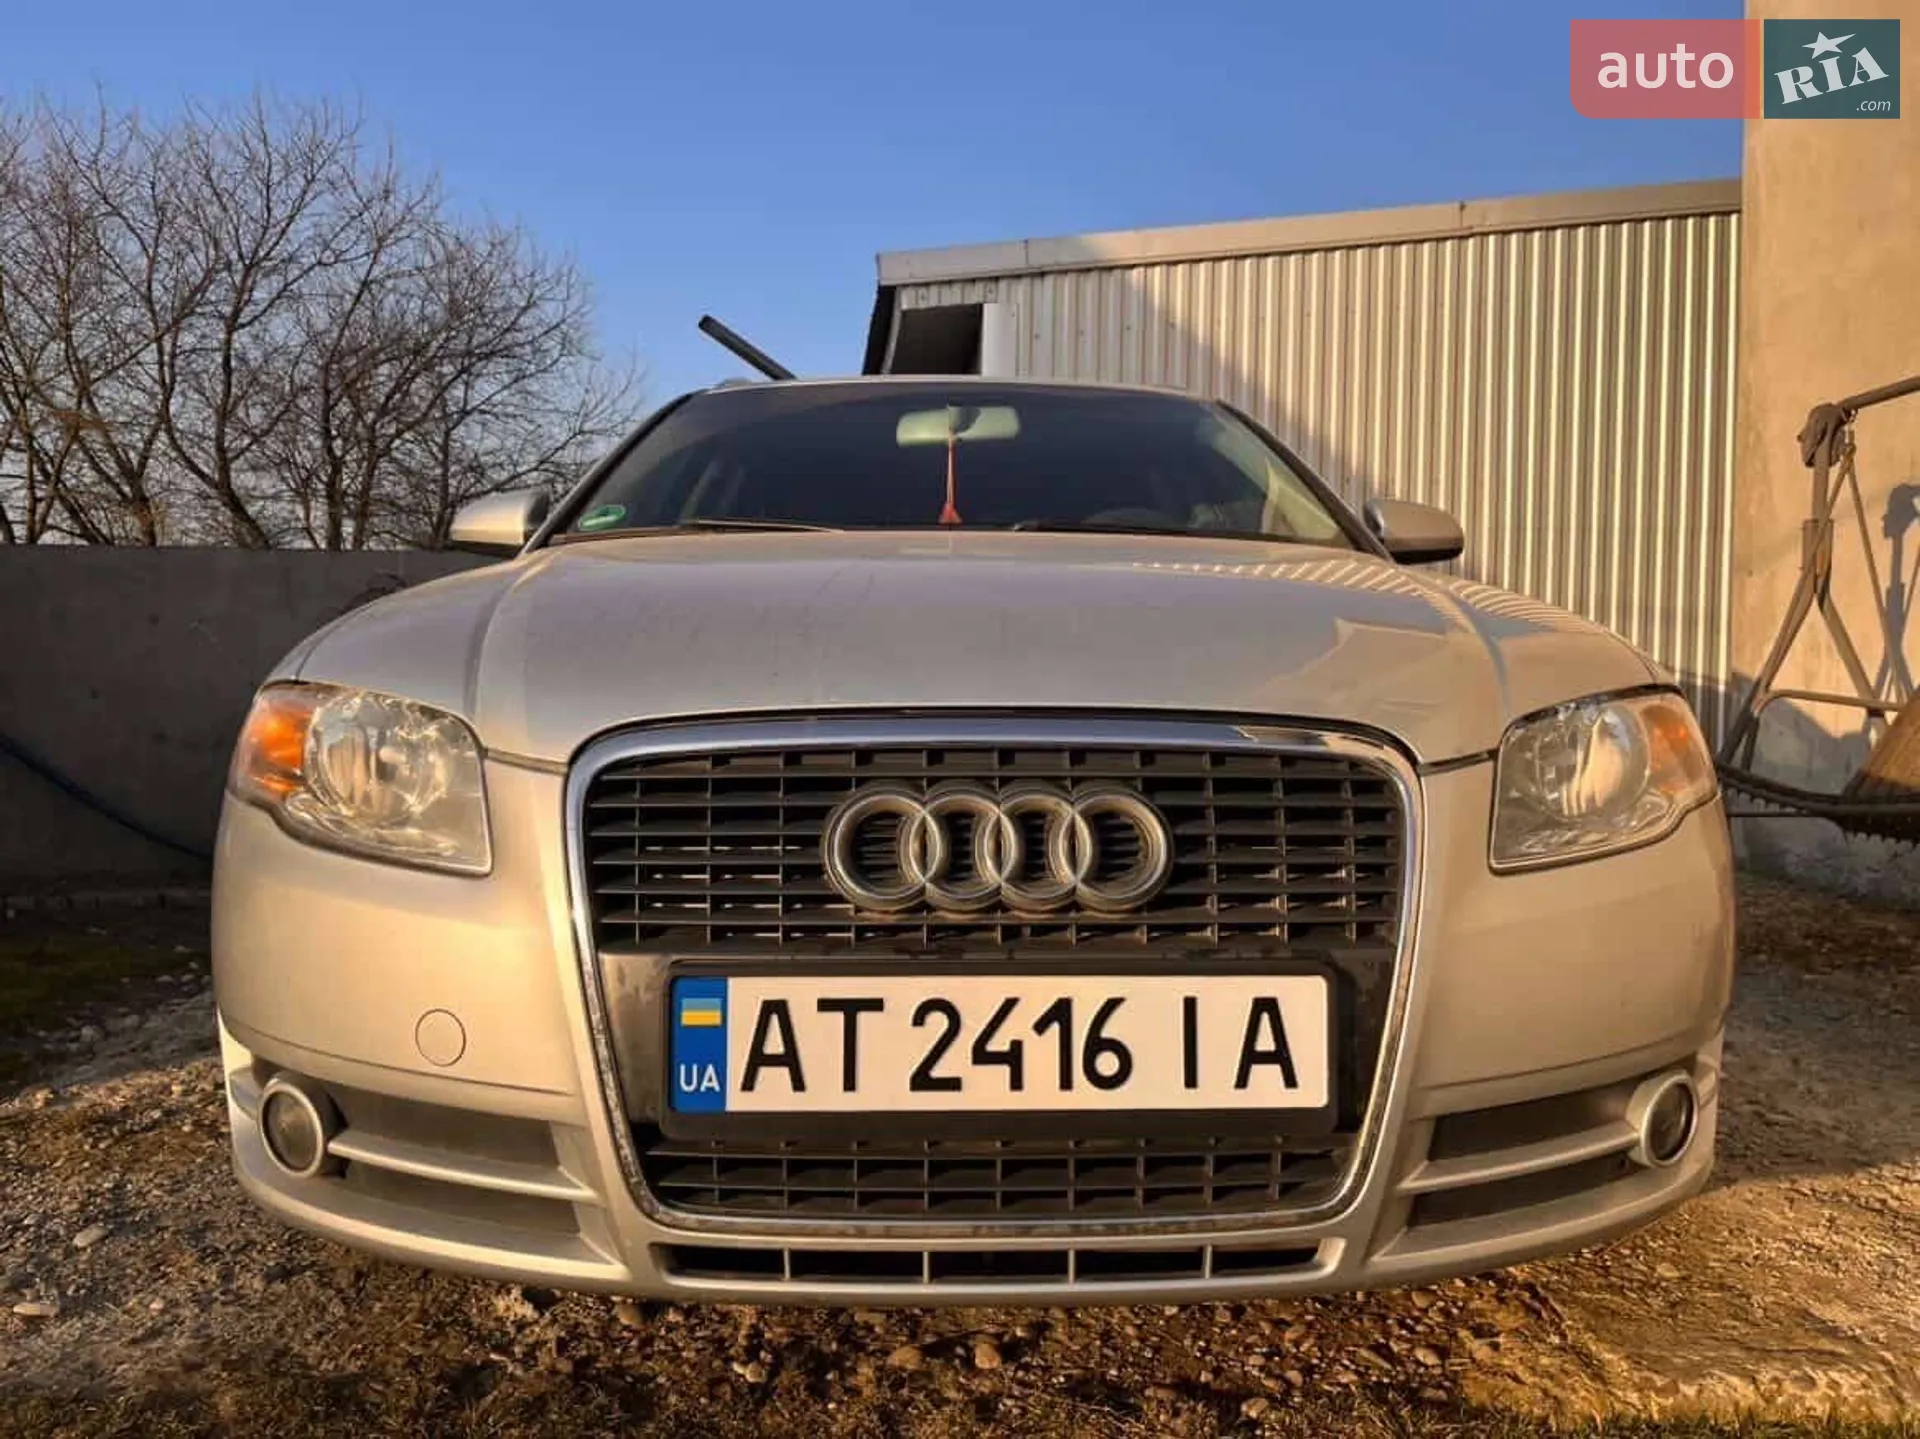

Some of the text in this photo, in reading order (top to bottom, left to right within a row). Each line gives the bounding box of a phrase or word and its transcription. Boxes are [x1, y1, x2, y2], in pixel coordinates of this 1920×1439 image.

[740, 997, 884, 1092] AT
[909, 997, 1134, 1091] 2416
[679, 1064, 721, 1093] UA
